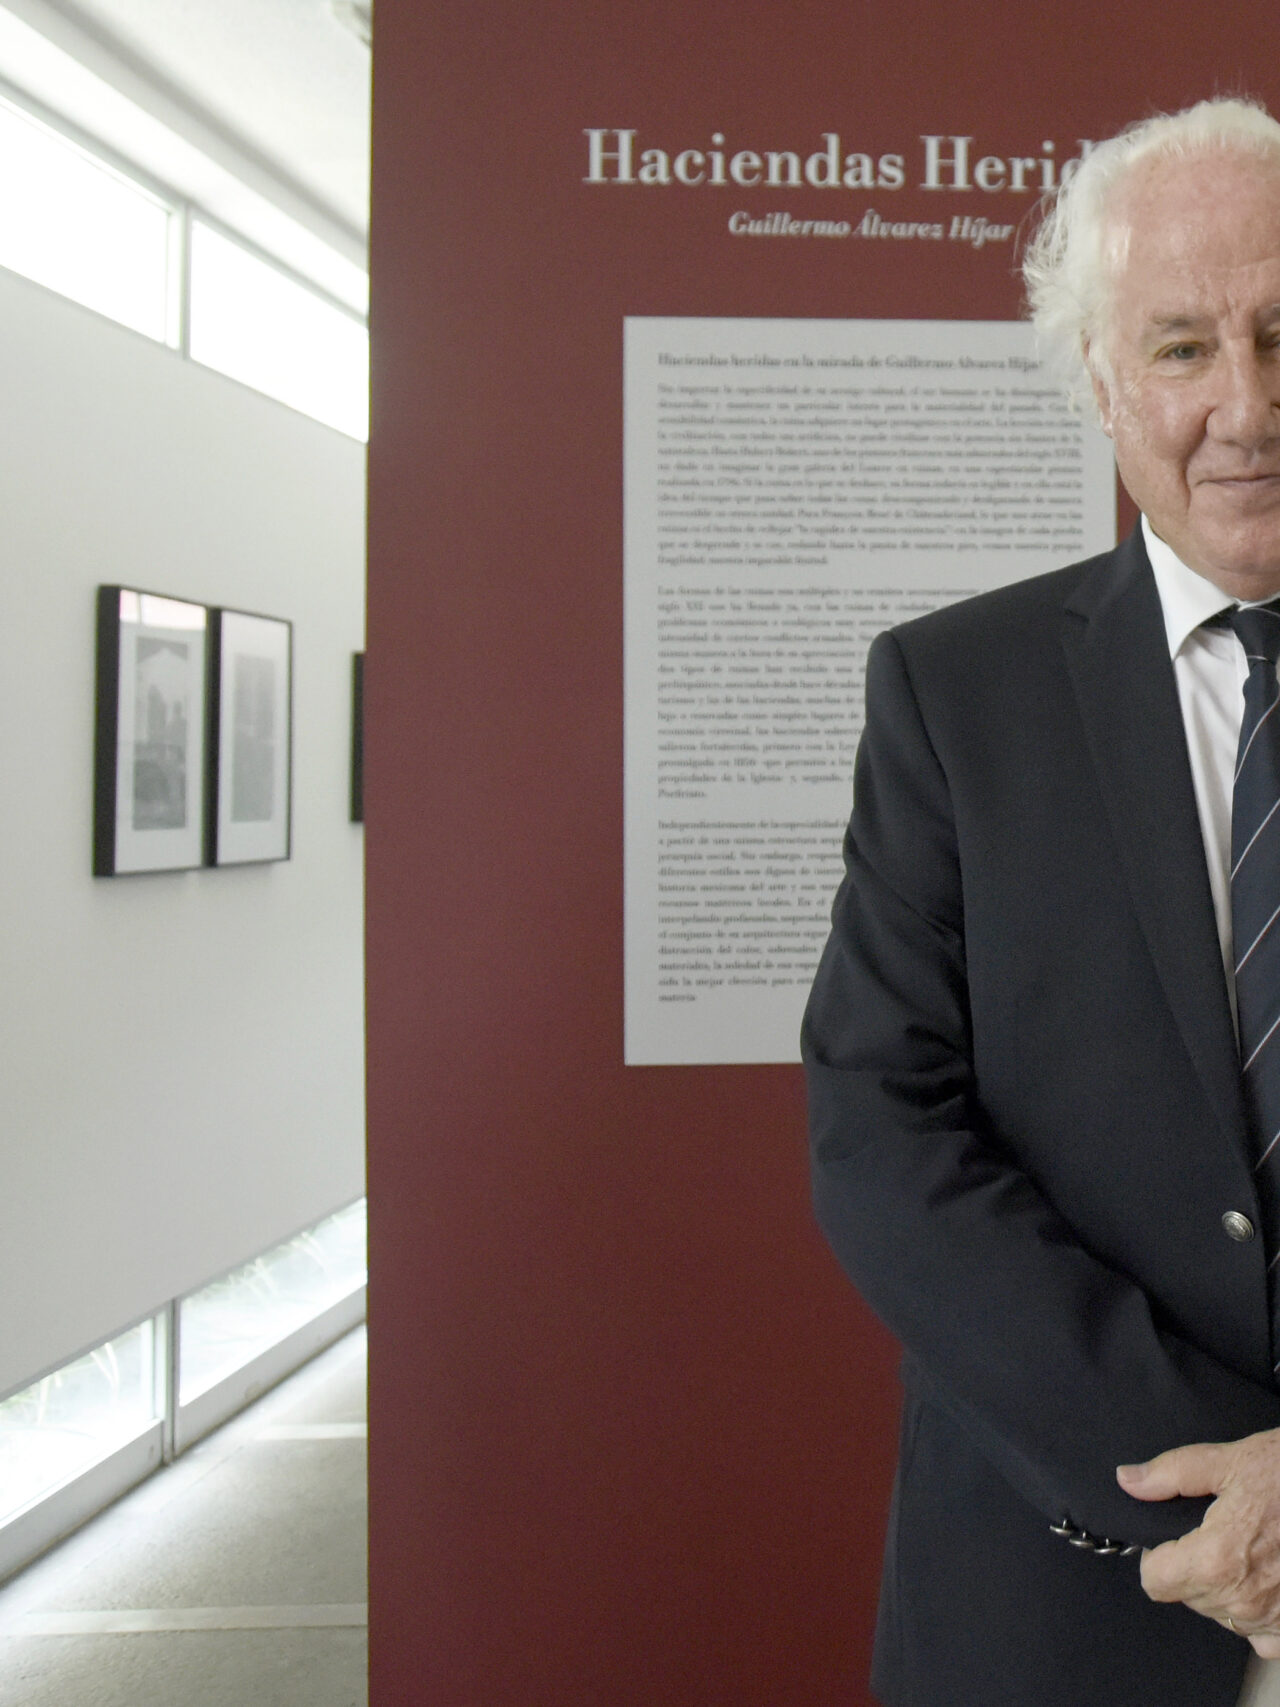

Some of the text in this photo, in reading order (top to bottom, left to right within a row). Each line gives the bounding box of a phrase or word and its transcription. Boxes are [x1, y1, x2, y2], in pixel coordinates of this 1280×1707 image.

[582, 128, 905, 190] Haciendas
[729, 211, 850, 238] Guillermo
[853, 208, 943, 240] Álvarez
[658, 352, 728, 366] Haciendas
[730, 353, 781, 367] heridas
[783, 357, 800, 367] en
[802, 353, 814, 367] la
[816, 354, 864, 368] mirada
[866, 354, 882, 368] de
[884, 355, 954, 369] Guillermo
